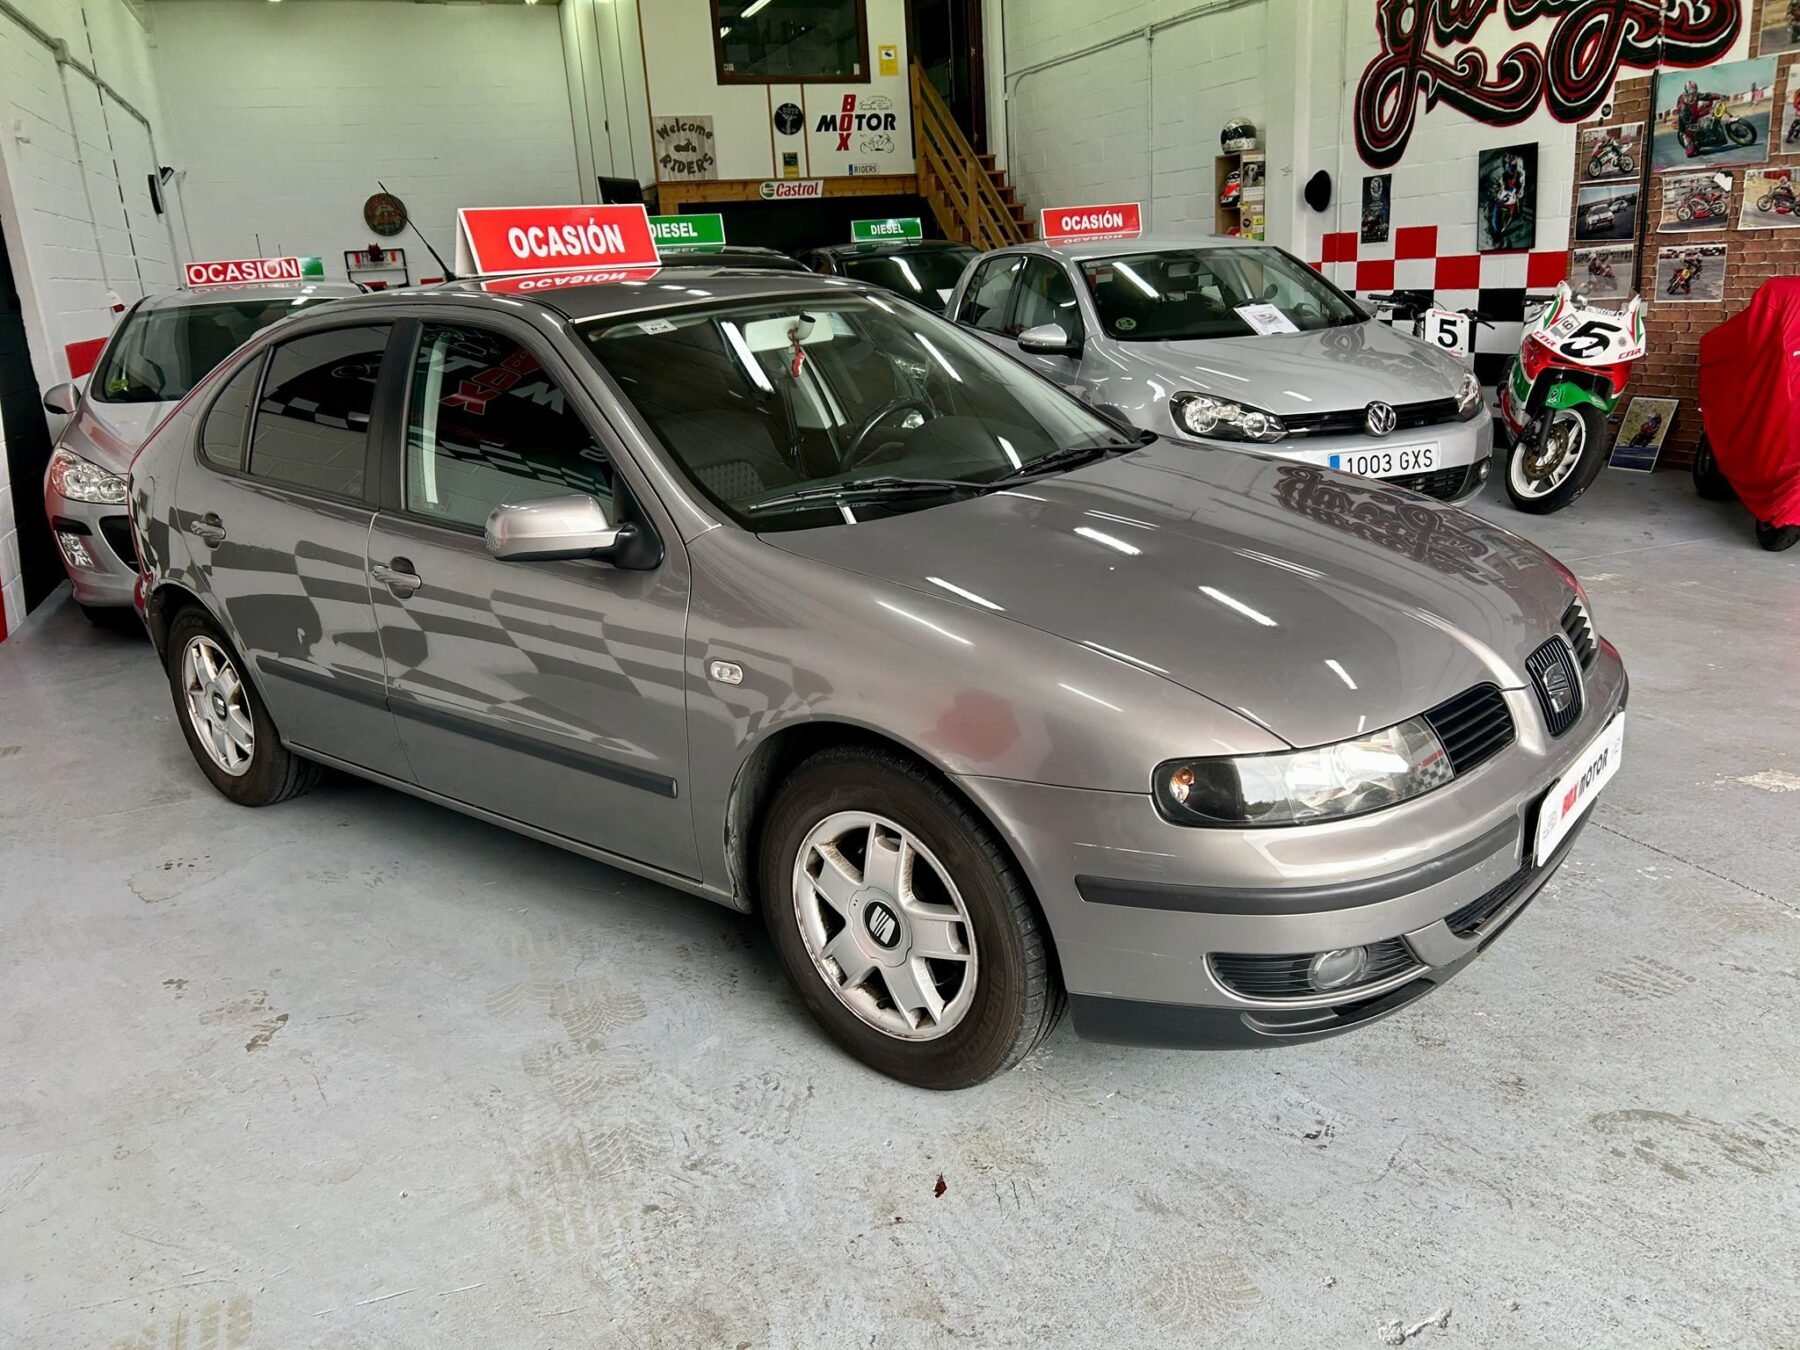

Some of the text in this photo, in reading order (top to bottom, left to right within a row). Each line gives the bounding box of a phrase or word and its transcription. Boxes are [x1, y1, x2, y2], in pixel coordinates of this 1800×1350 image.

[656, 118, 713, 140] Welcome
[815, 113, 897, 132] MOTOR
[836, 94, 857, 151] BOX
[659, 152, 714, 175] RIDERS
[776, 182, 819, 197] Castrol
[870, 223, 905, 235] DIESEL
[1061, 210, 1123, 231] OCASIÓN
[508, 218, 626, 259] OCASIÓN
[1437, 318, 1459, 349] 5
[1560, 321, 1622, 359] 5
[1618, 348, 1642, 359] CBR
[1346, 449, 1433, 475] 1003 GXS
[1578, 747, 1609, 798] MOTOR
